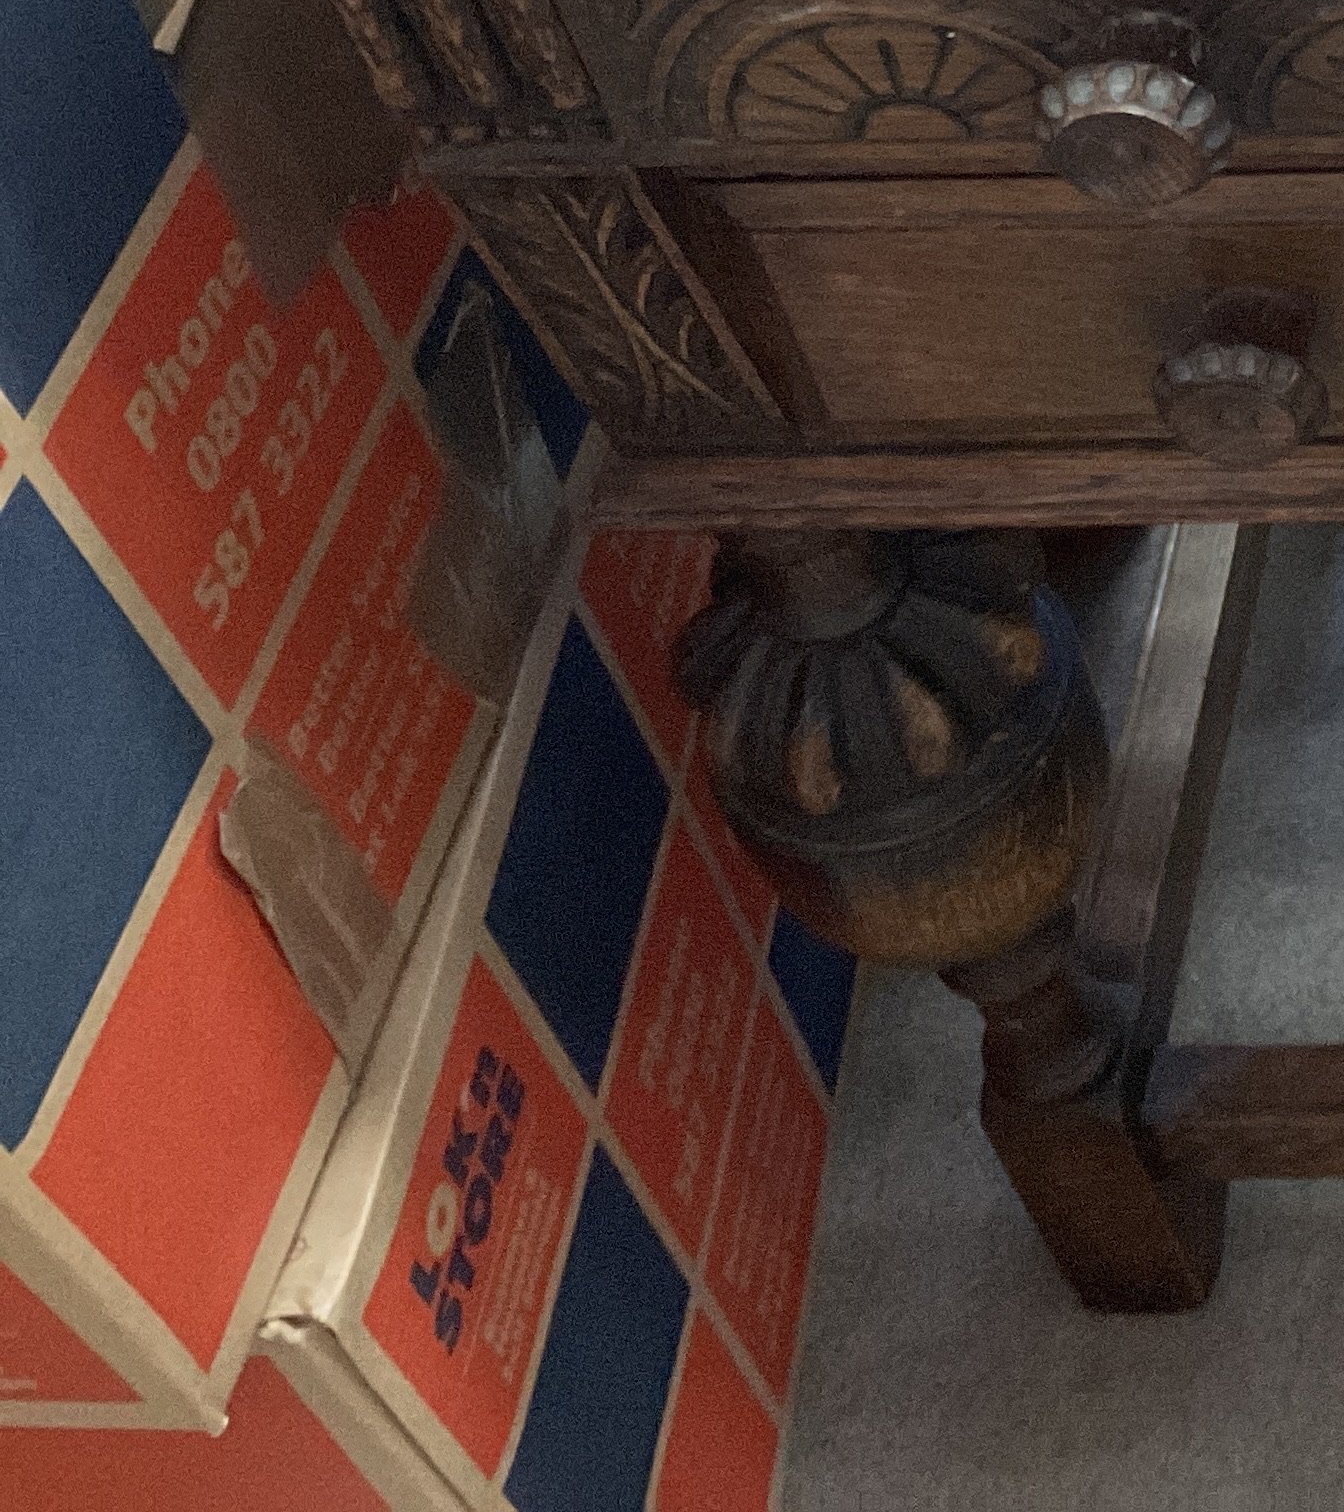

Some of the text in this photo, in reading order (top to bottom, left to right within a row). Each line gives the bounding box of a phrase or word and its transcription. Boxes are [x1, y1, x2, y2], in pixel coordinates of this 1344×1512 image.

[123, 238, 252, 456] Phone
[186, 323, 278, 492] 0800
[193, 327, 349, 633] 587 3322
[433, 1062, 526, 1357] STORE
